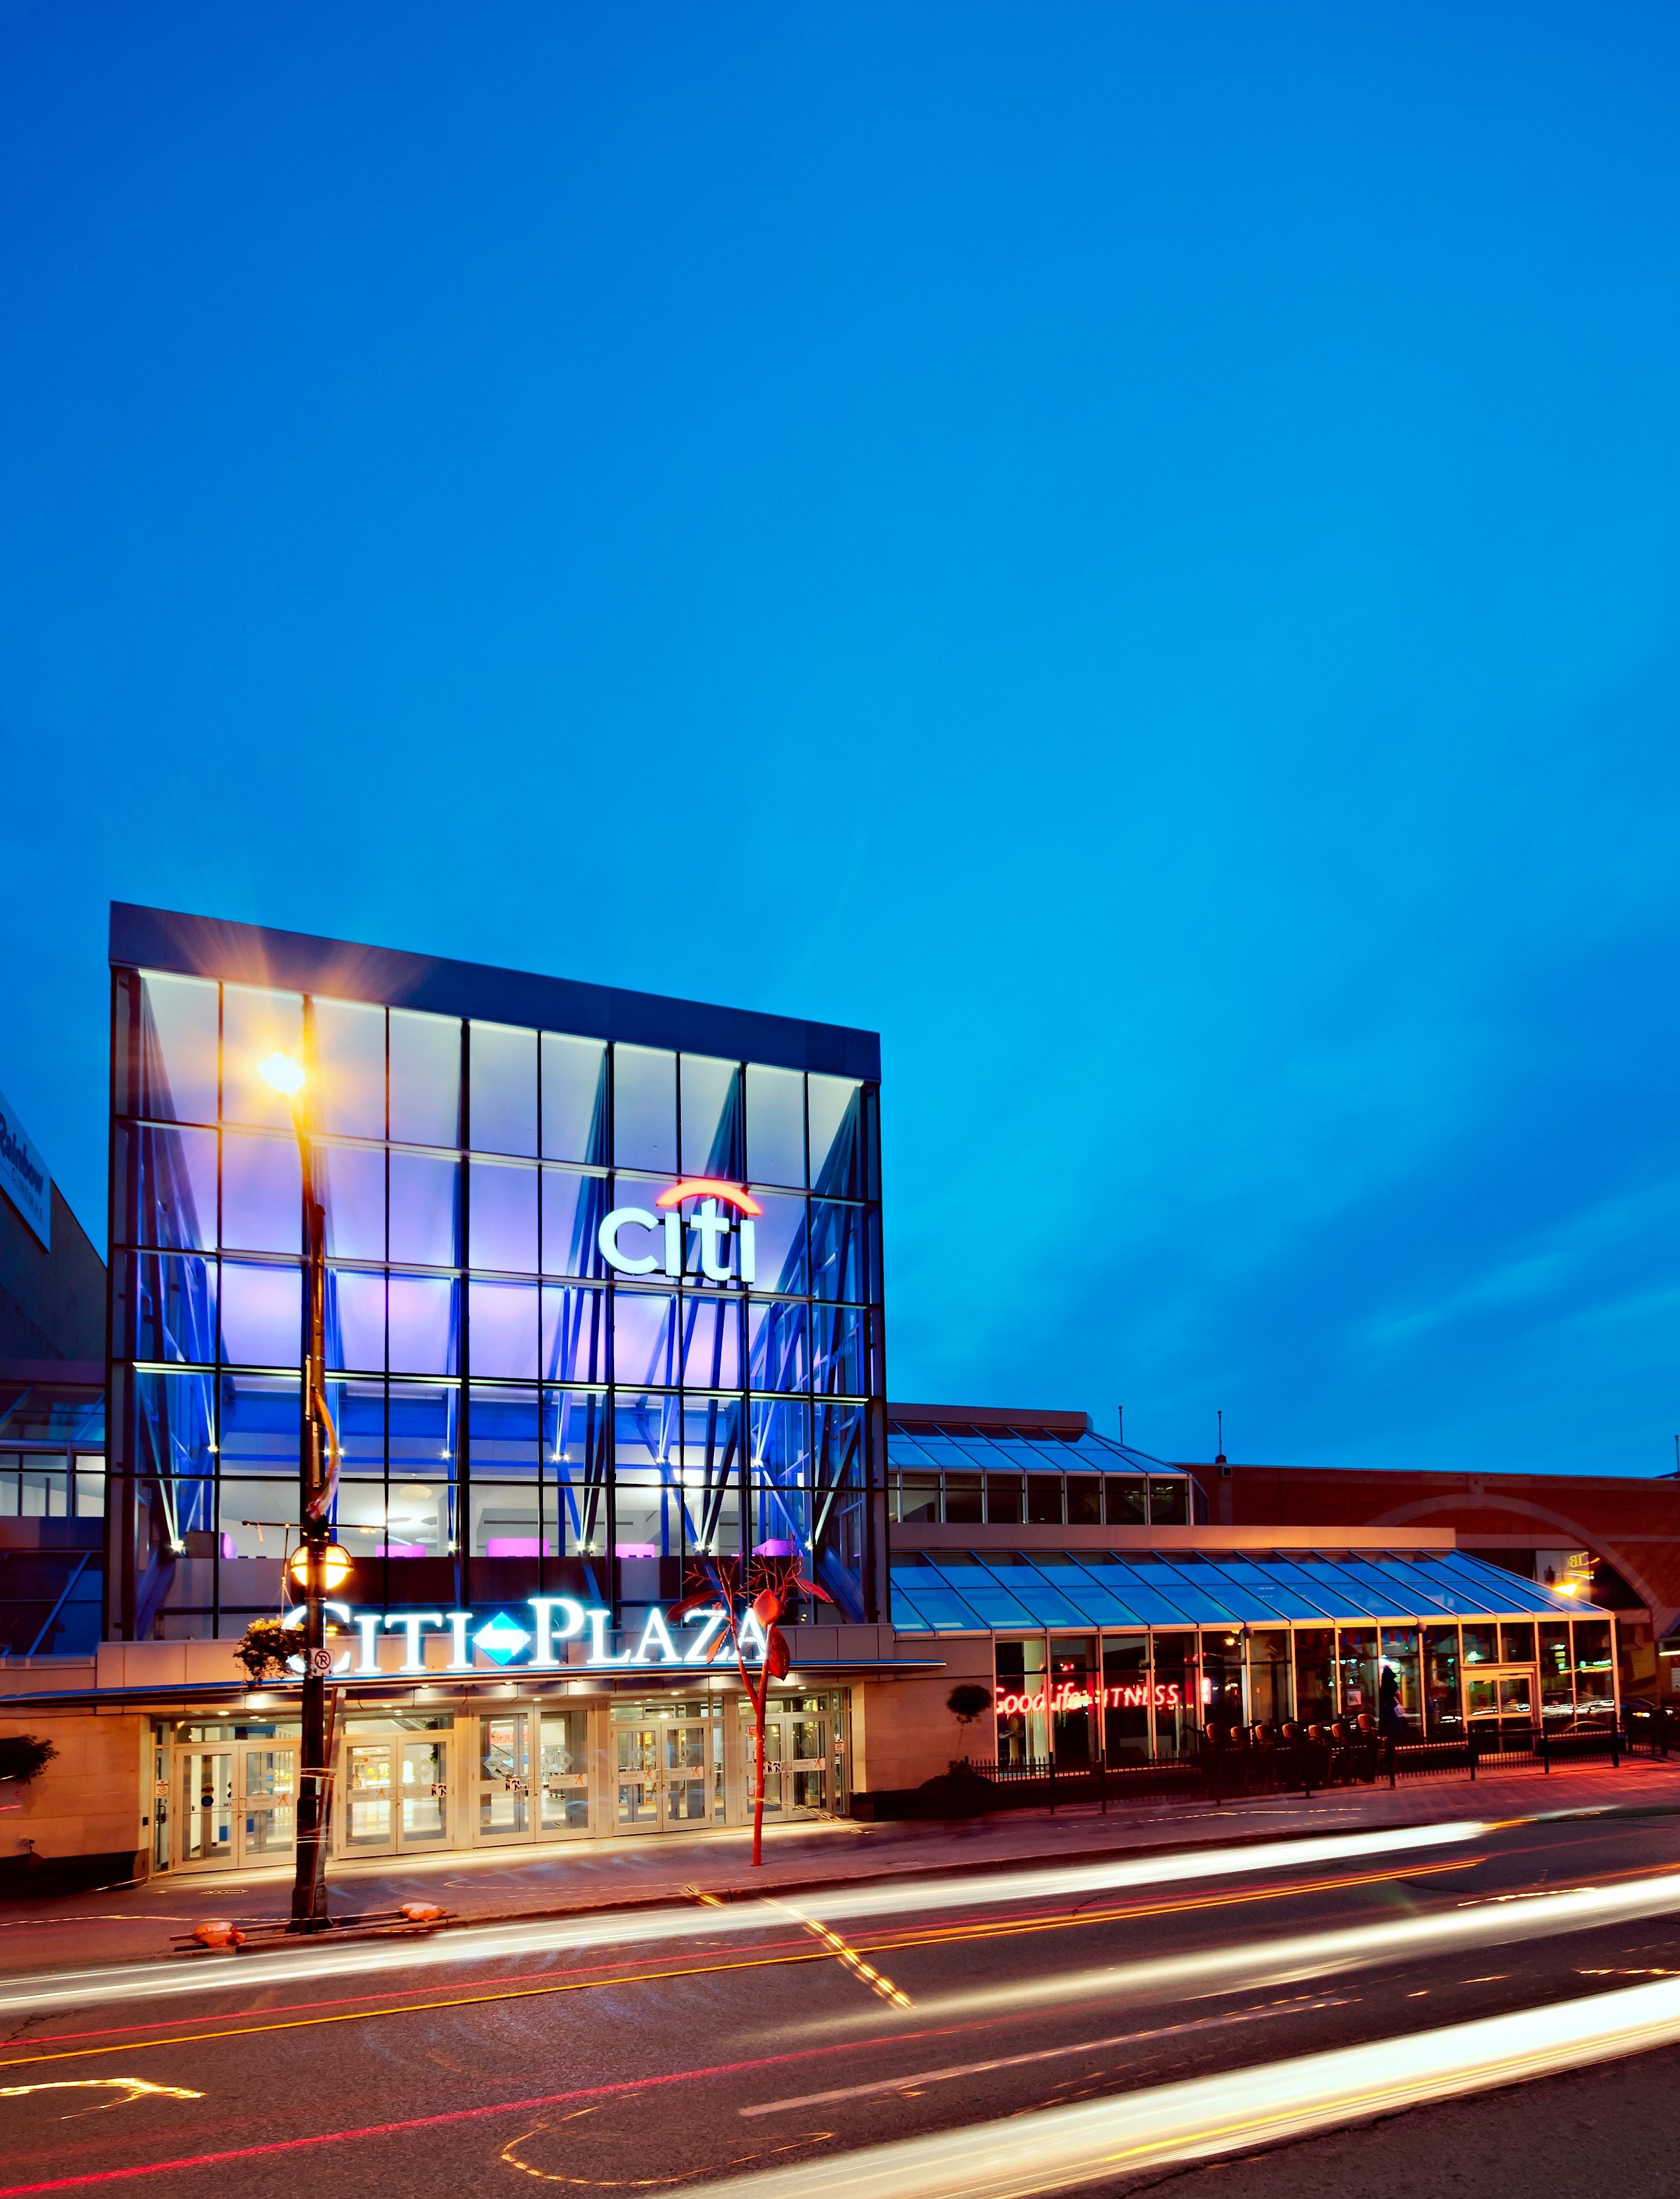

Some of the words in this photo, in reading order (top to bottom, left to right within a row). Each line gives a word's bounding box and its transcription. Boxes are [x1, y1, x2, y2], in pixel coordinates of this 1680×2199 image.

[598, 1198, 755, 1283] citi
[528, 1598, 767, 1666] PLAZA
[1100, 1684, 1179, 1708] ITNESS
